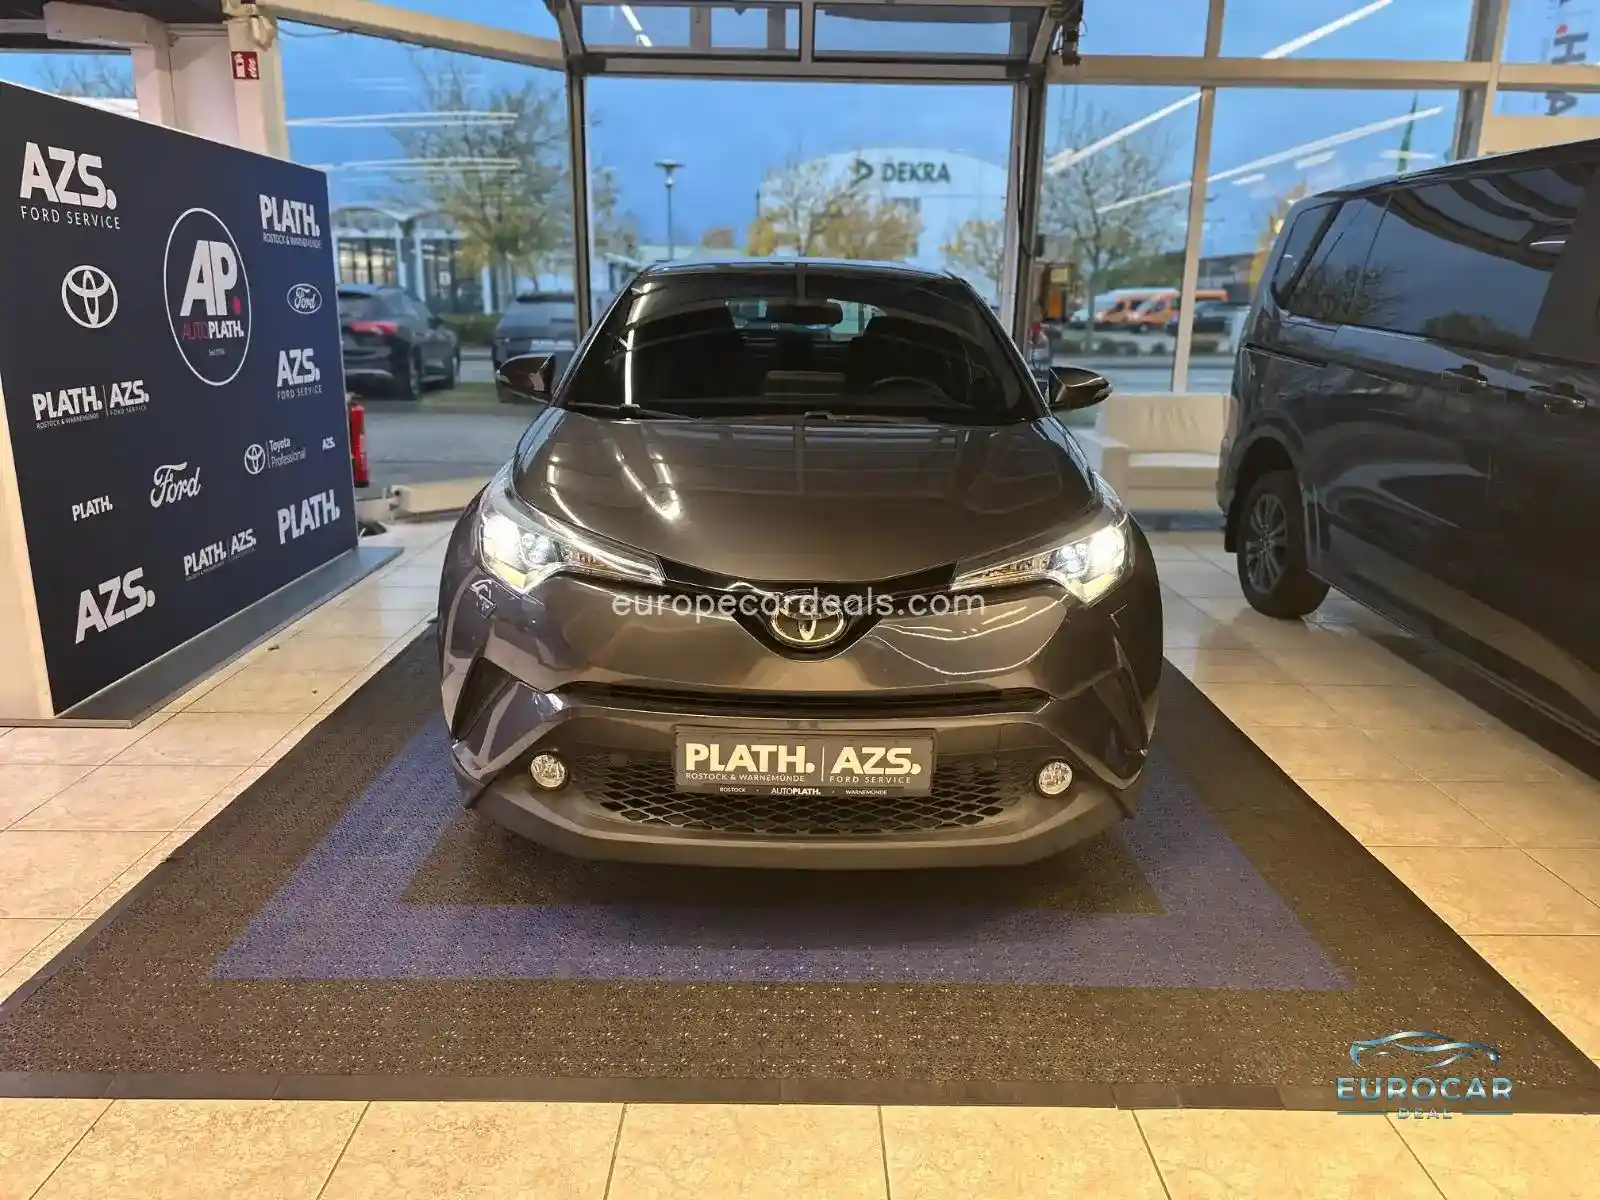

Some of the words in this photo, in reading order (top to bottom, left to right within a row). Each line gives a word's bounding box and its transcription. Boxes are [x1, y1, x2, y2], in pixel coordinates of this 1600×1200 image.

[20, 141, 117, 210] AZS.
[881, 161, 951, 183] DEKRA
[21, 206, 60, 224] FORD
[67, 211, 121, 230] SERVICE
[259, 194, 321, 238] PLATH.
[294, 287, 316, 309] Ford
[277, 348, 320, 387] AZS.
[32, 386, 103, 421] PLATH.
[110, 380, 150, 409] AZS.
[277, 390, 295, 402] FORD
[297, 385, 322, 397] SERVICE
[269, 437, 291, 453] Toyota
[271, 447, 306, 467] Professional
[150, 462, 201, 508] Ford
[72, 495, 113, 522] PLATH.
[277, 489, 340, 545] PLATH.
[184, 540, 227, 576] PLATH.
[231, 528, 257, 555] AZS.
[75, 567, 155, 645] AZS.
[685, 742, 816, 774] PLATH.
[830, 746, 922, 775] AZS.
[685, 772, 728, 781] ROSTOCK
[739, 773, 805, 783] WARNEMÜNDE
[829, 776, 860, 784] FORD
[864, 776, 912, 784] SERVICE
[771, 787, 821, 796] AUTOPLATH.
